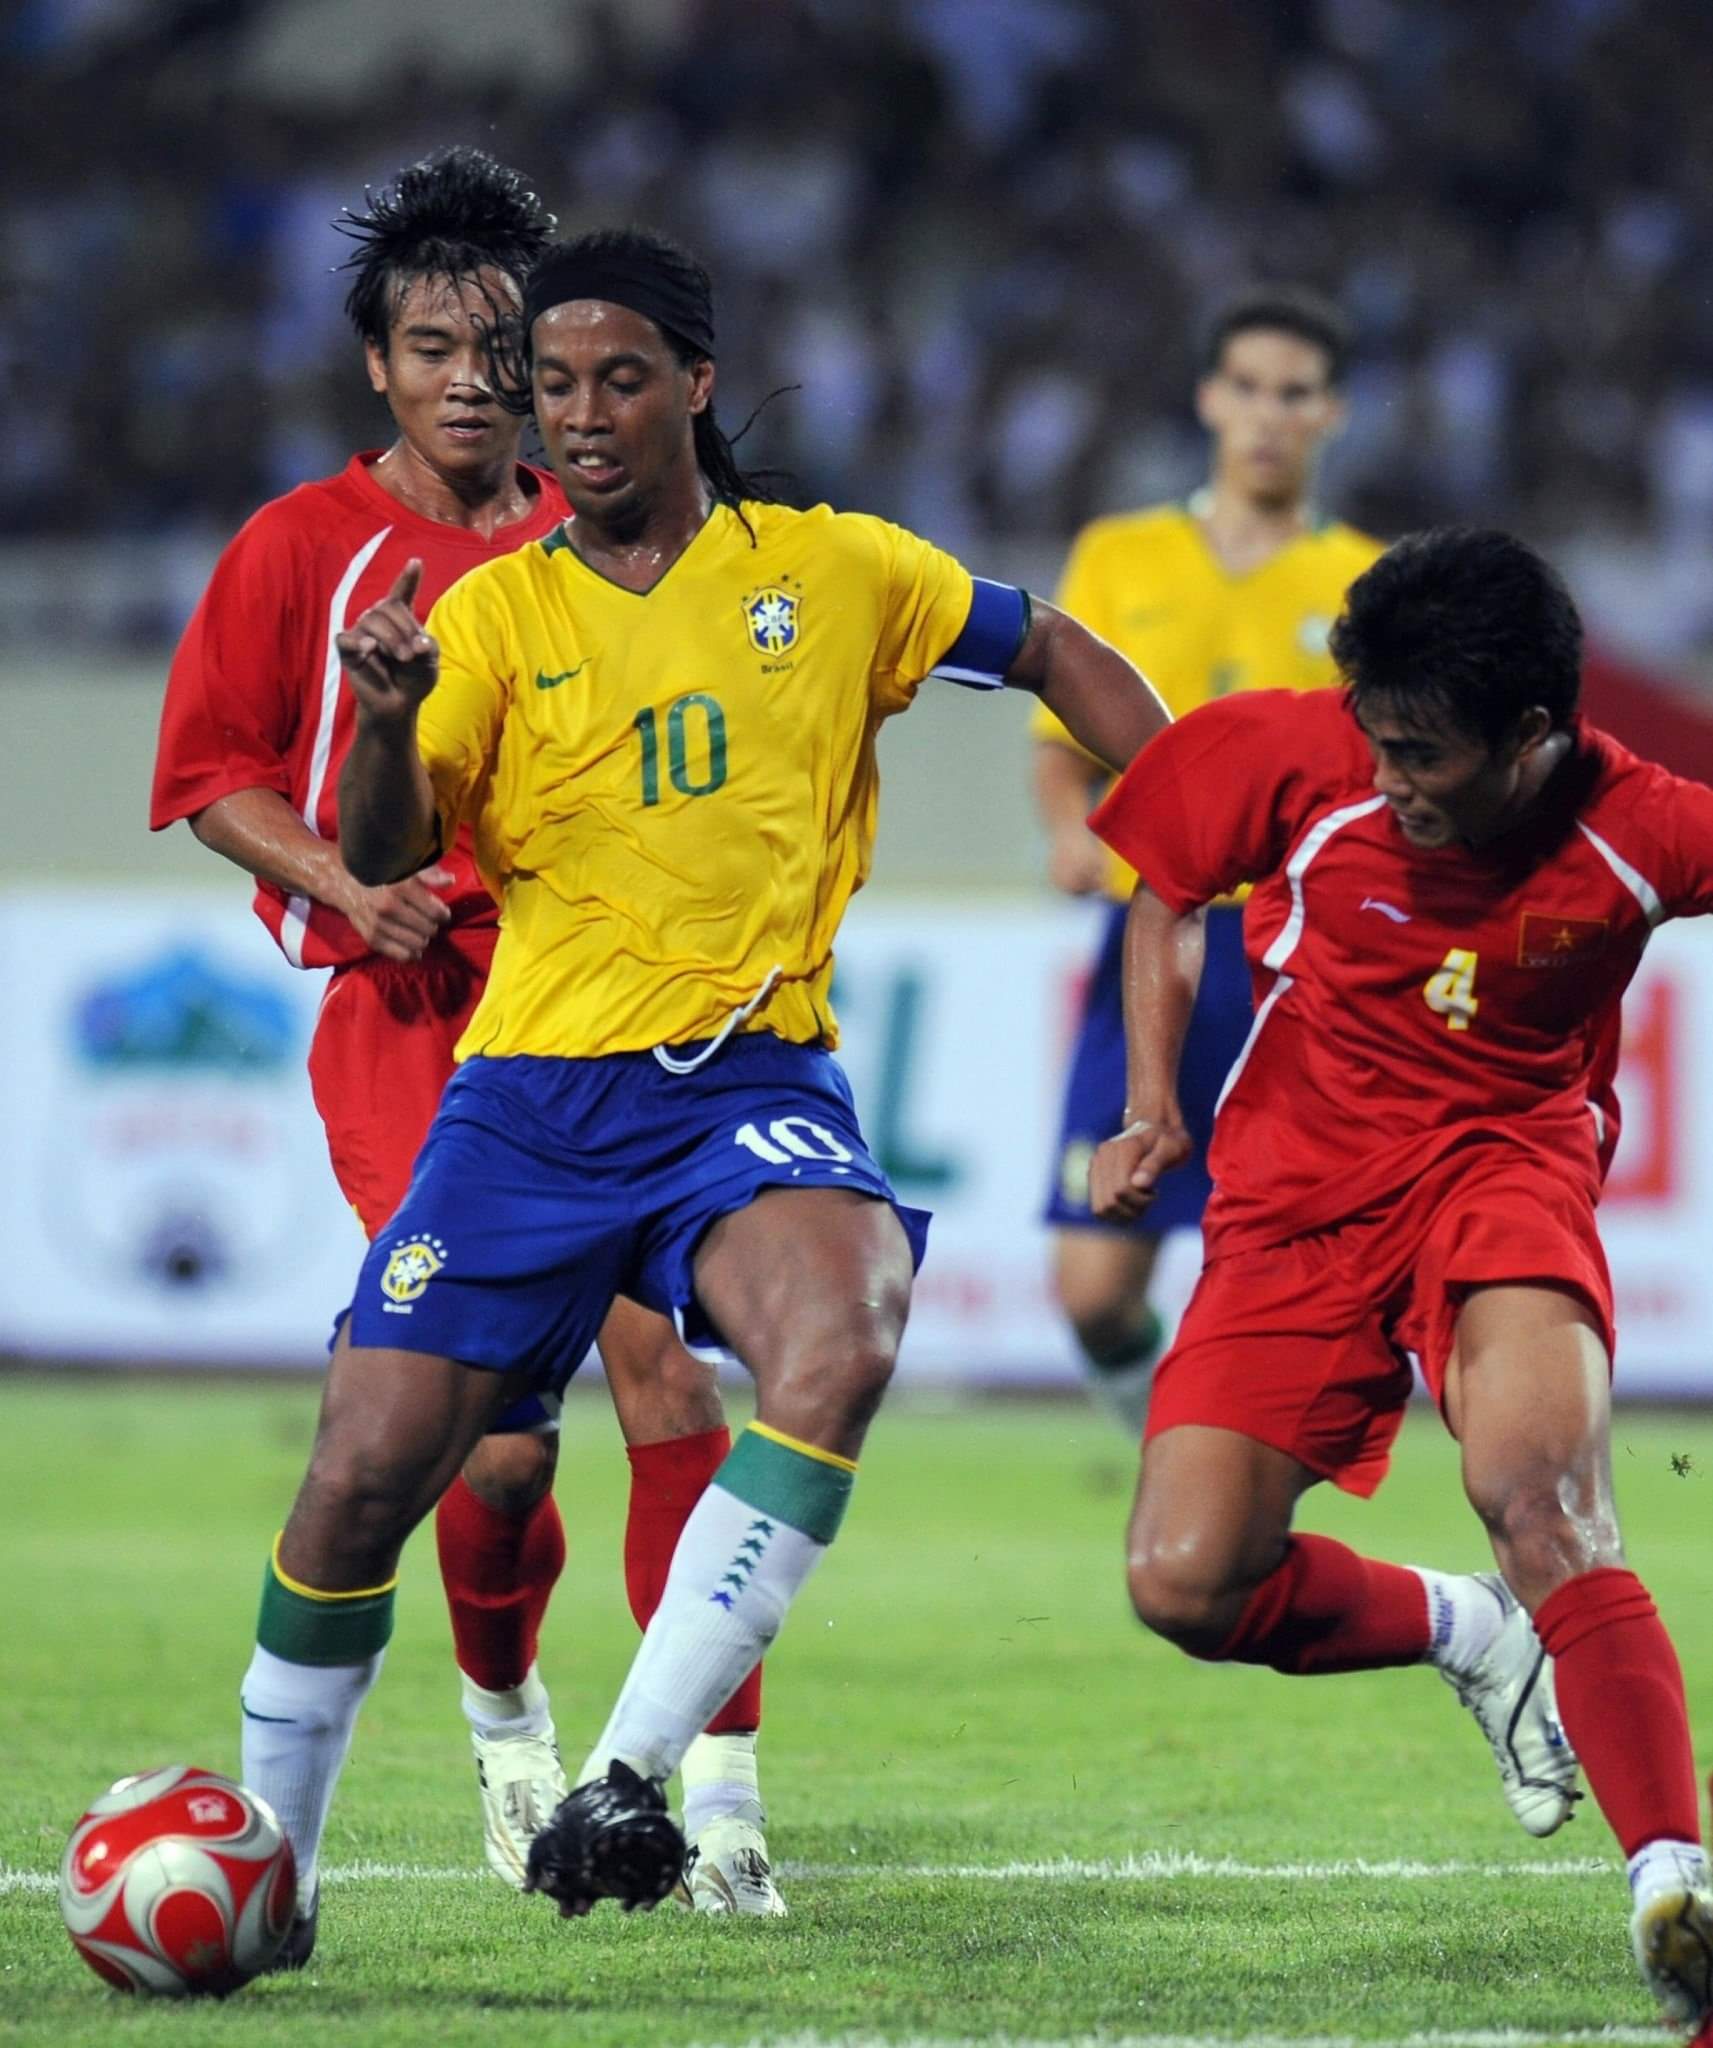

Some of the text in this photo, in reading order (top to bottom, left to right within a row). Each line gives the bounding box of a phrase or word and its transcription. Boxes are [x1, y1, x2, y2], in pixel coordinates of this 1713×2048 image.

[632, 694, 728, 807] 10
[1422, 947, 1479, 1031] 4
[734, 1116, 853, 1165] 10
